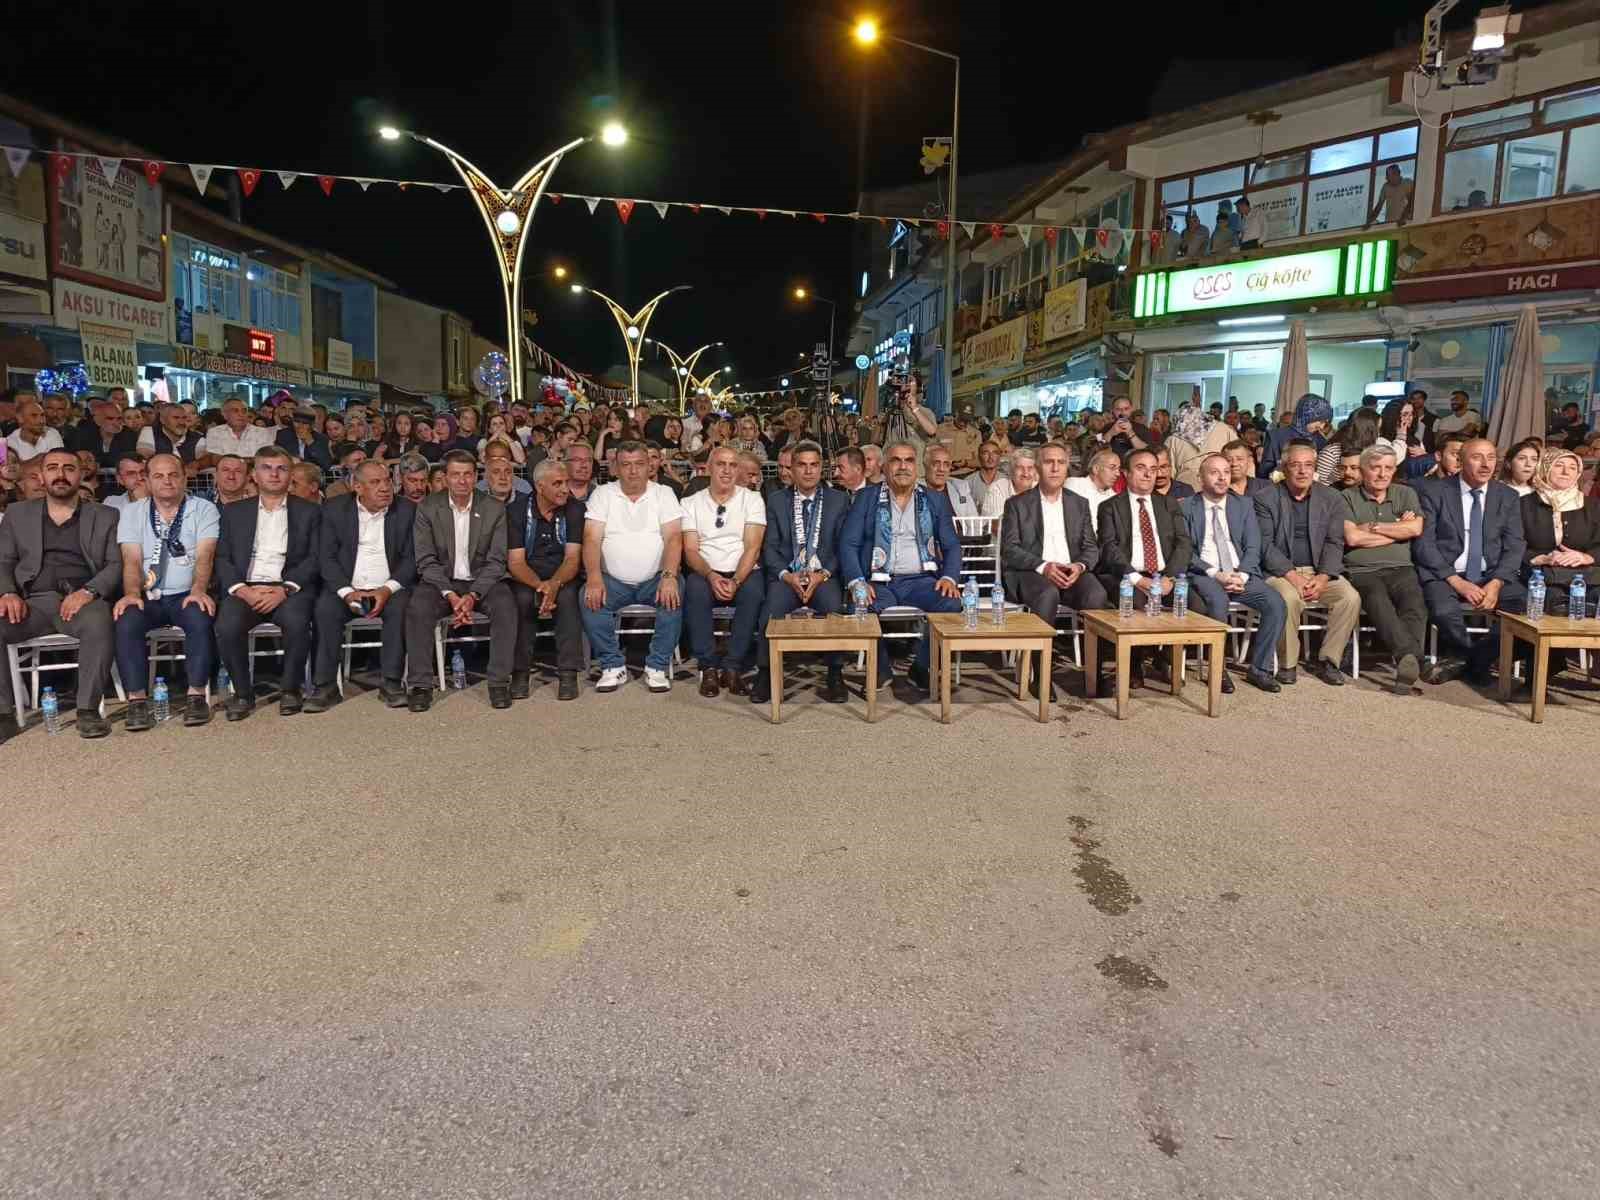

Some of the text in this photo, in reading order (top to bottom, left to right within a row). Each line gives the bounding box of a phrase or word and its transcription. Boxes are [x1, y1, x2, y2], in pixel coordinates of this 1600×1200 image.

[1507, 272, 1559, 291] HACI
[63, 289, 165, 329] AKSU TİCARET
[93, 345, 135, 368] ALANA
[94, 365, 135, 387] BEDAVA
